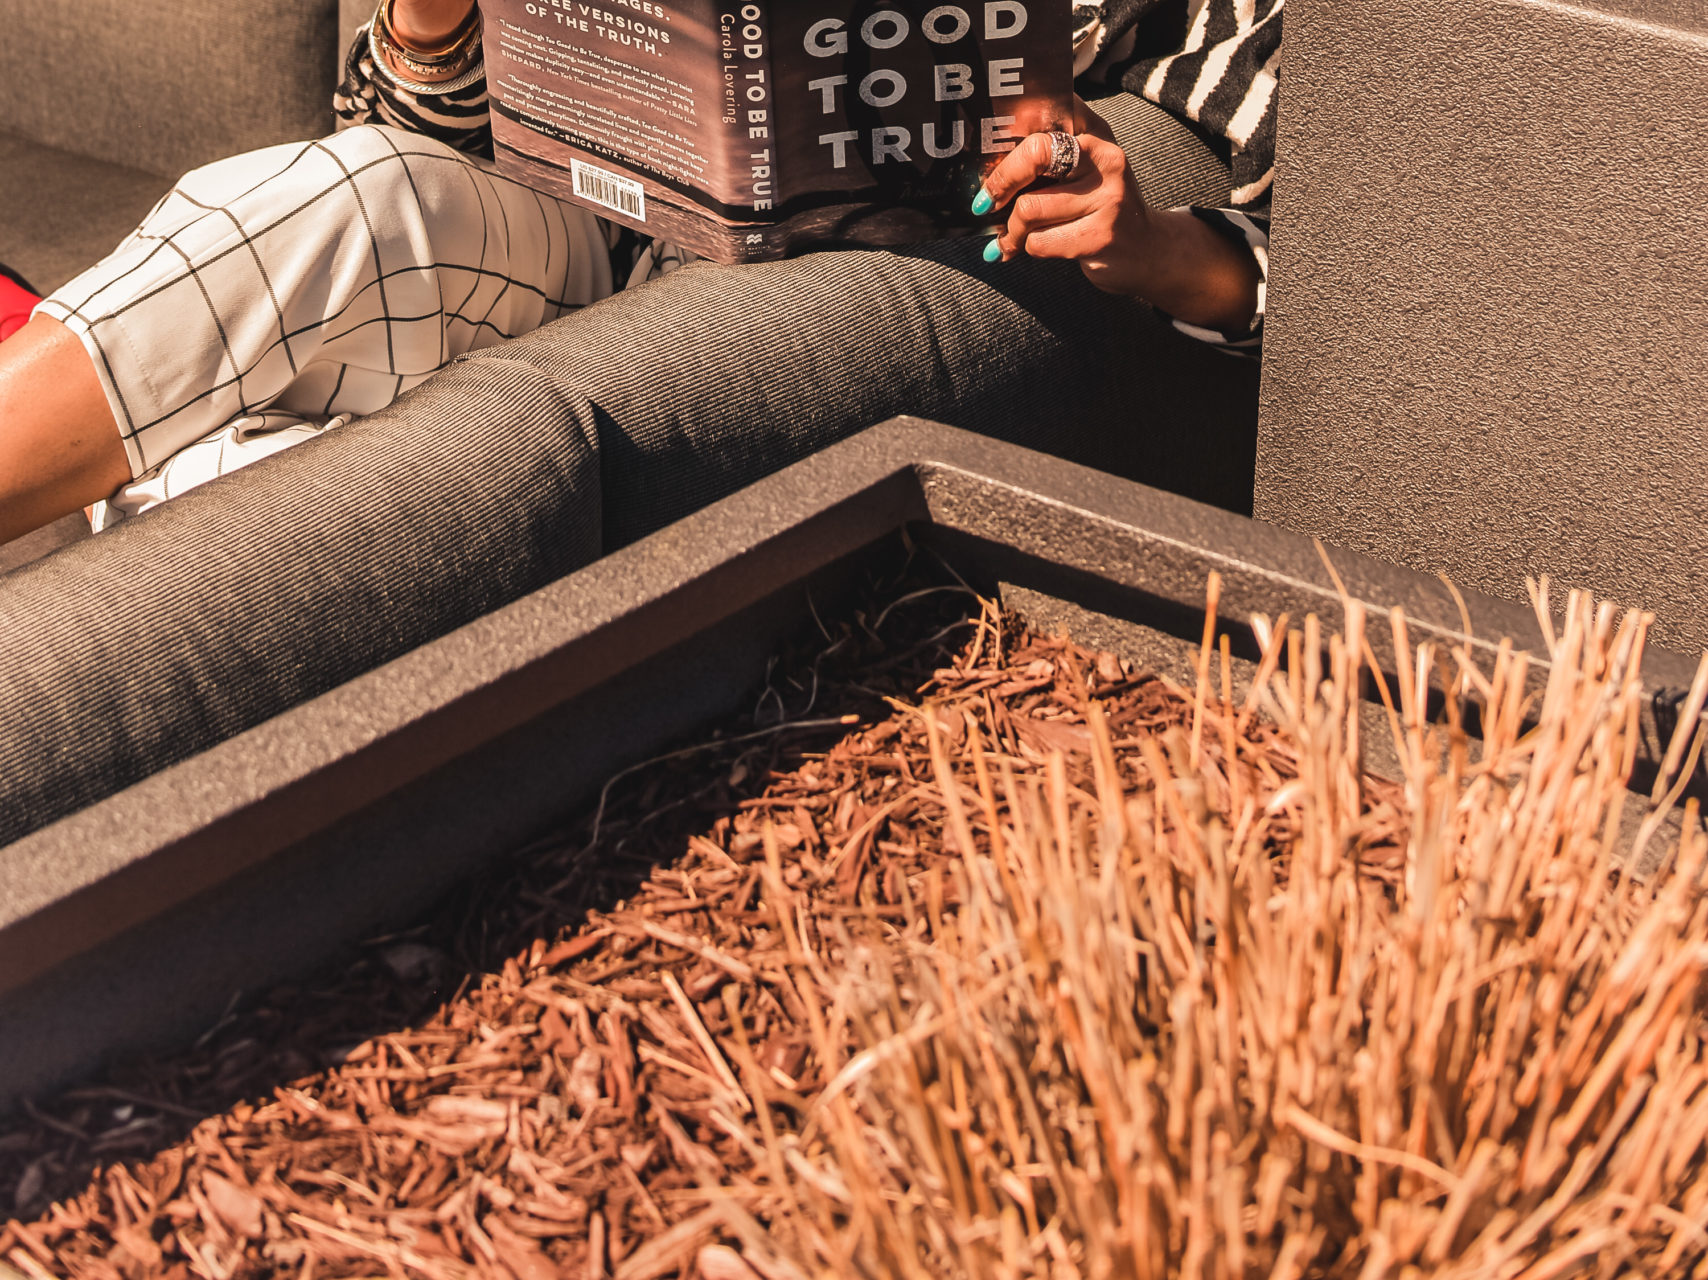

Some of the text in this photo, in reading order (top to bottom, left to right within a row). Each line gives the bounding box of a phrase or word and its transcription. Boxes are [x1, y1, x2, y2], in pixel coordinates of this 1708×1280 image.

[525, 2, 663, 58] OF THE TRUTH.
[578, 3, 670, 44] VERSIONS
[803, 0, 1028, 58] GOOD
[501, 49, 545, 72] SHEPARD,
[720, 13, 741, 124] Carola Lovering
[745, 69, 766, 102] TO
[808, 58, 1024, 114] TO BE
[748, 109, 768, 139] BE
[818, 115, 1017, 169] TRUE
[595, 144, 622, 160] KATZ,
[751, 148, 773, 212] TRUE
